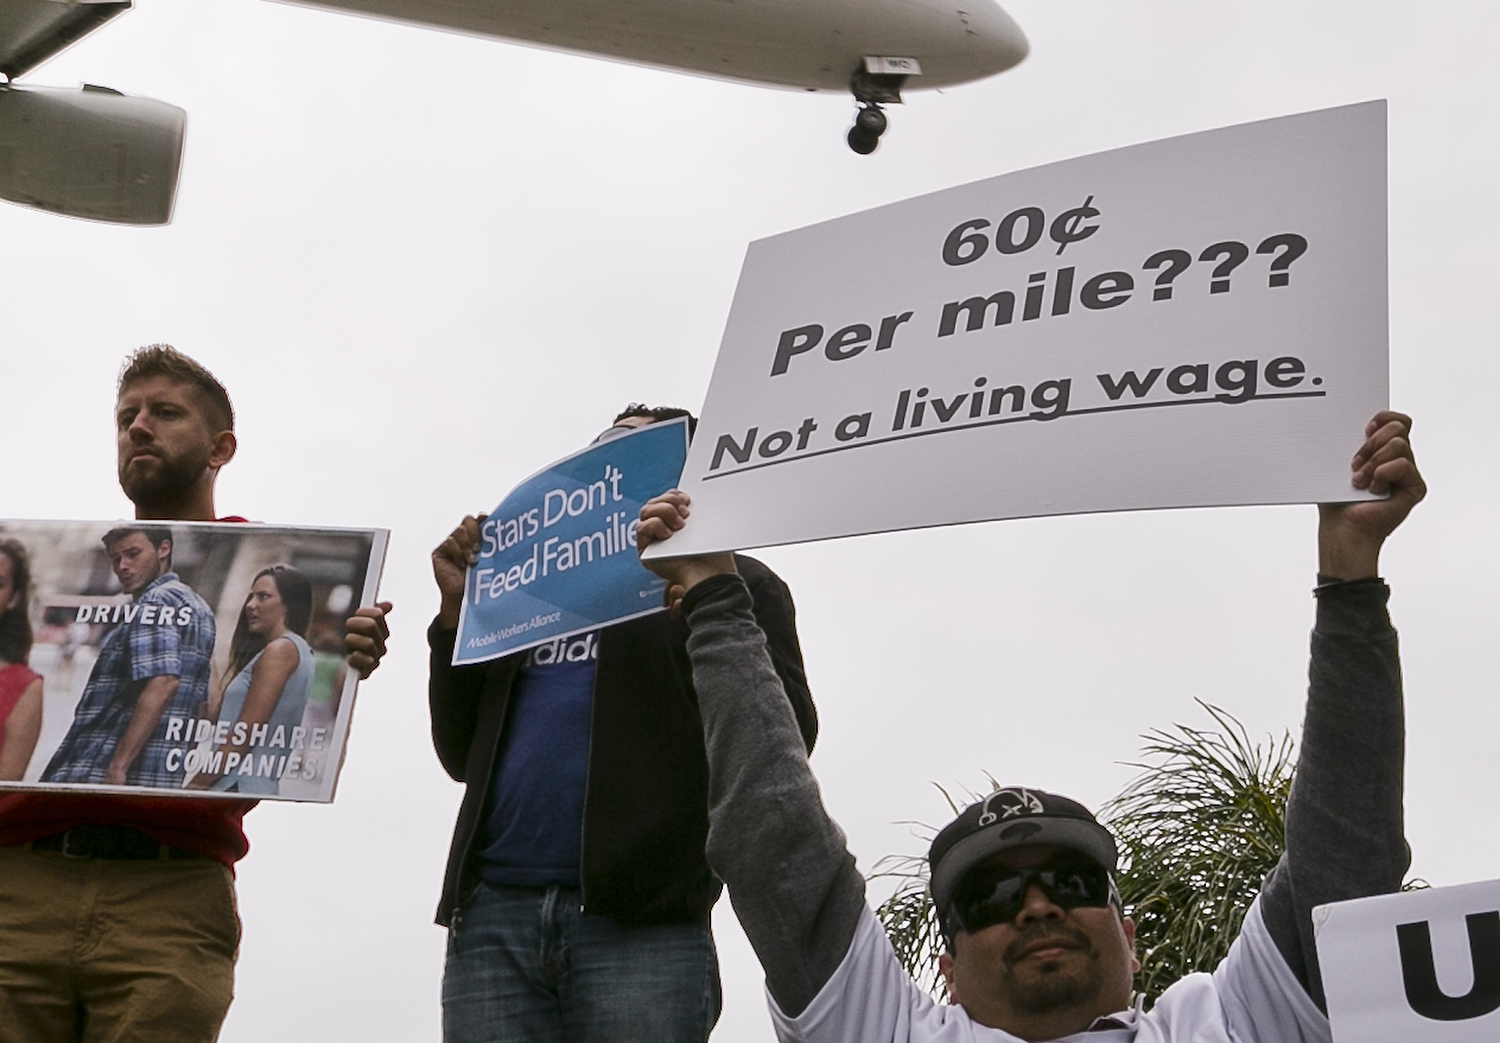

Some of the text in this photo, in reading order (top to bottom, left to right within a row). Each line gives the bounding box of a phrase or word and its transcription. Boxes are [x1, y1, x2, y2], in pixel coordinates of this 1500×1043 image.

[942, 195, 1102, 267] 60¢
[769, 233, 1308, 377] Per mile???
[709, 356, 1324, 471] Not a living wage.
[480, 508, 539, 558] Stars
[474, 511, 638, 606] Feed Familie
[75, 603, 193, 628] DRIVERS
[466, 611, 562, 649] Mobile Workers Alliance
[165, 718, 327, 752] RIDESHARE
[165, 747, 319, 781] COMPANIES
